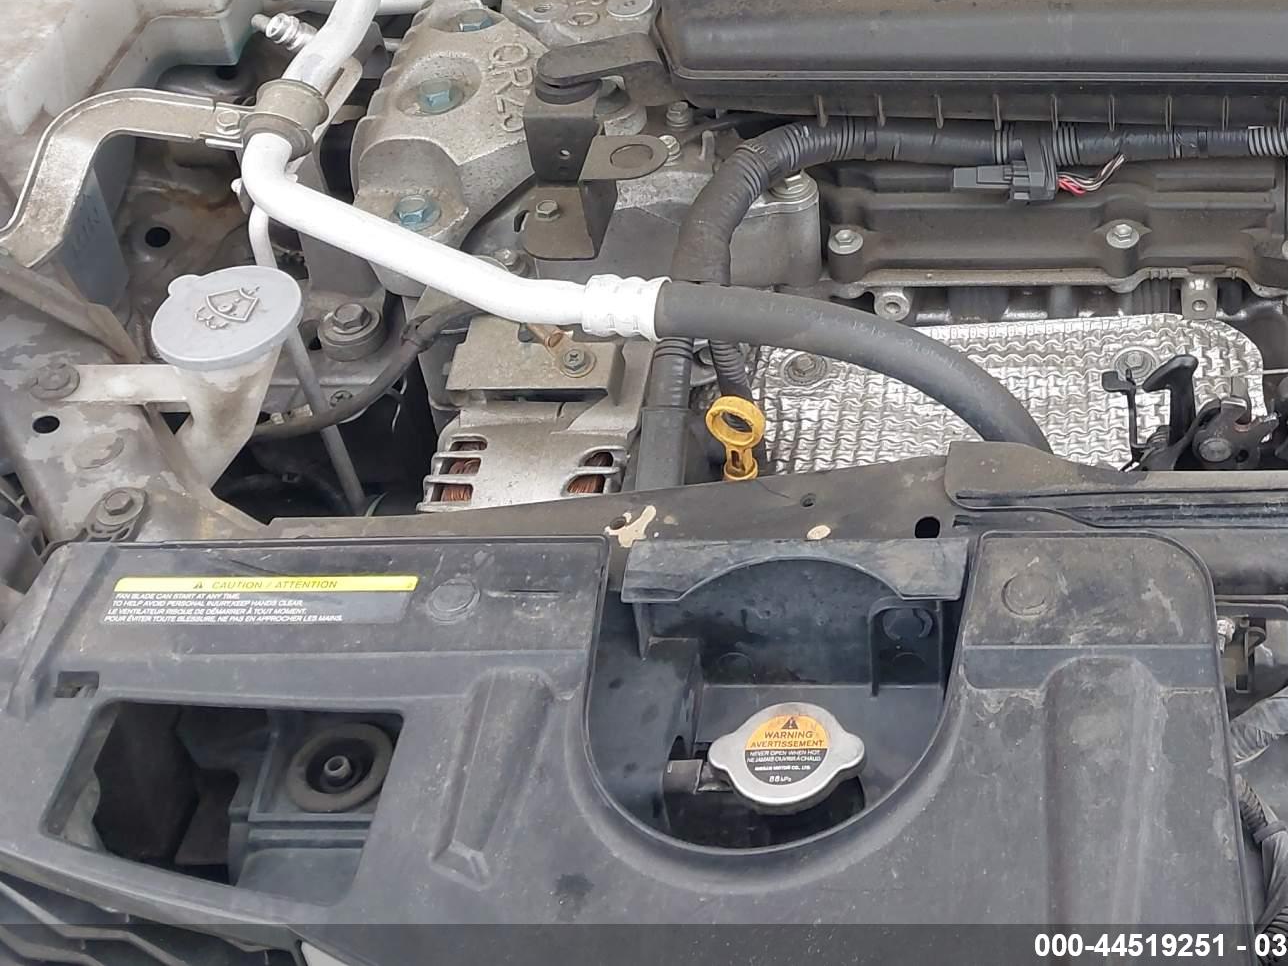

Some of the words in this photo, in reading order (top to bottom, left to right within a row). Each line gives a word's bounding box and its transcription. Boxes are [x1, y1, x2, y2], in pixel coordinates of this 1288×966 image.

[211, 581, 263, 589] CAUTION
[274, 580, 338, 589] ATTENTION
[764, 731, 813, 739] WARNING
[751, 739, 824, 748] AVERTISSEMENT
